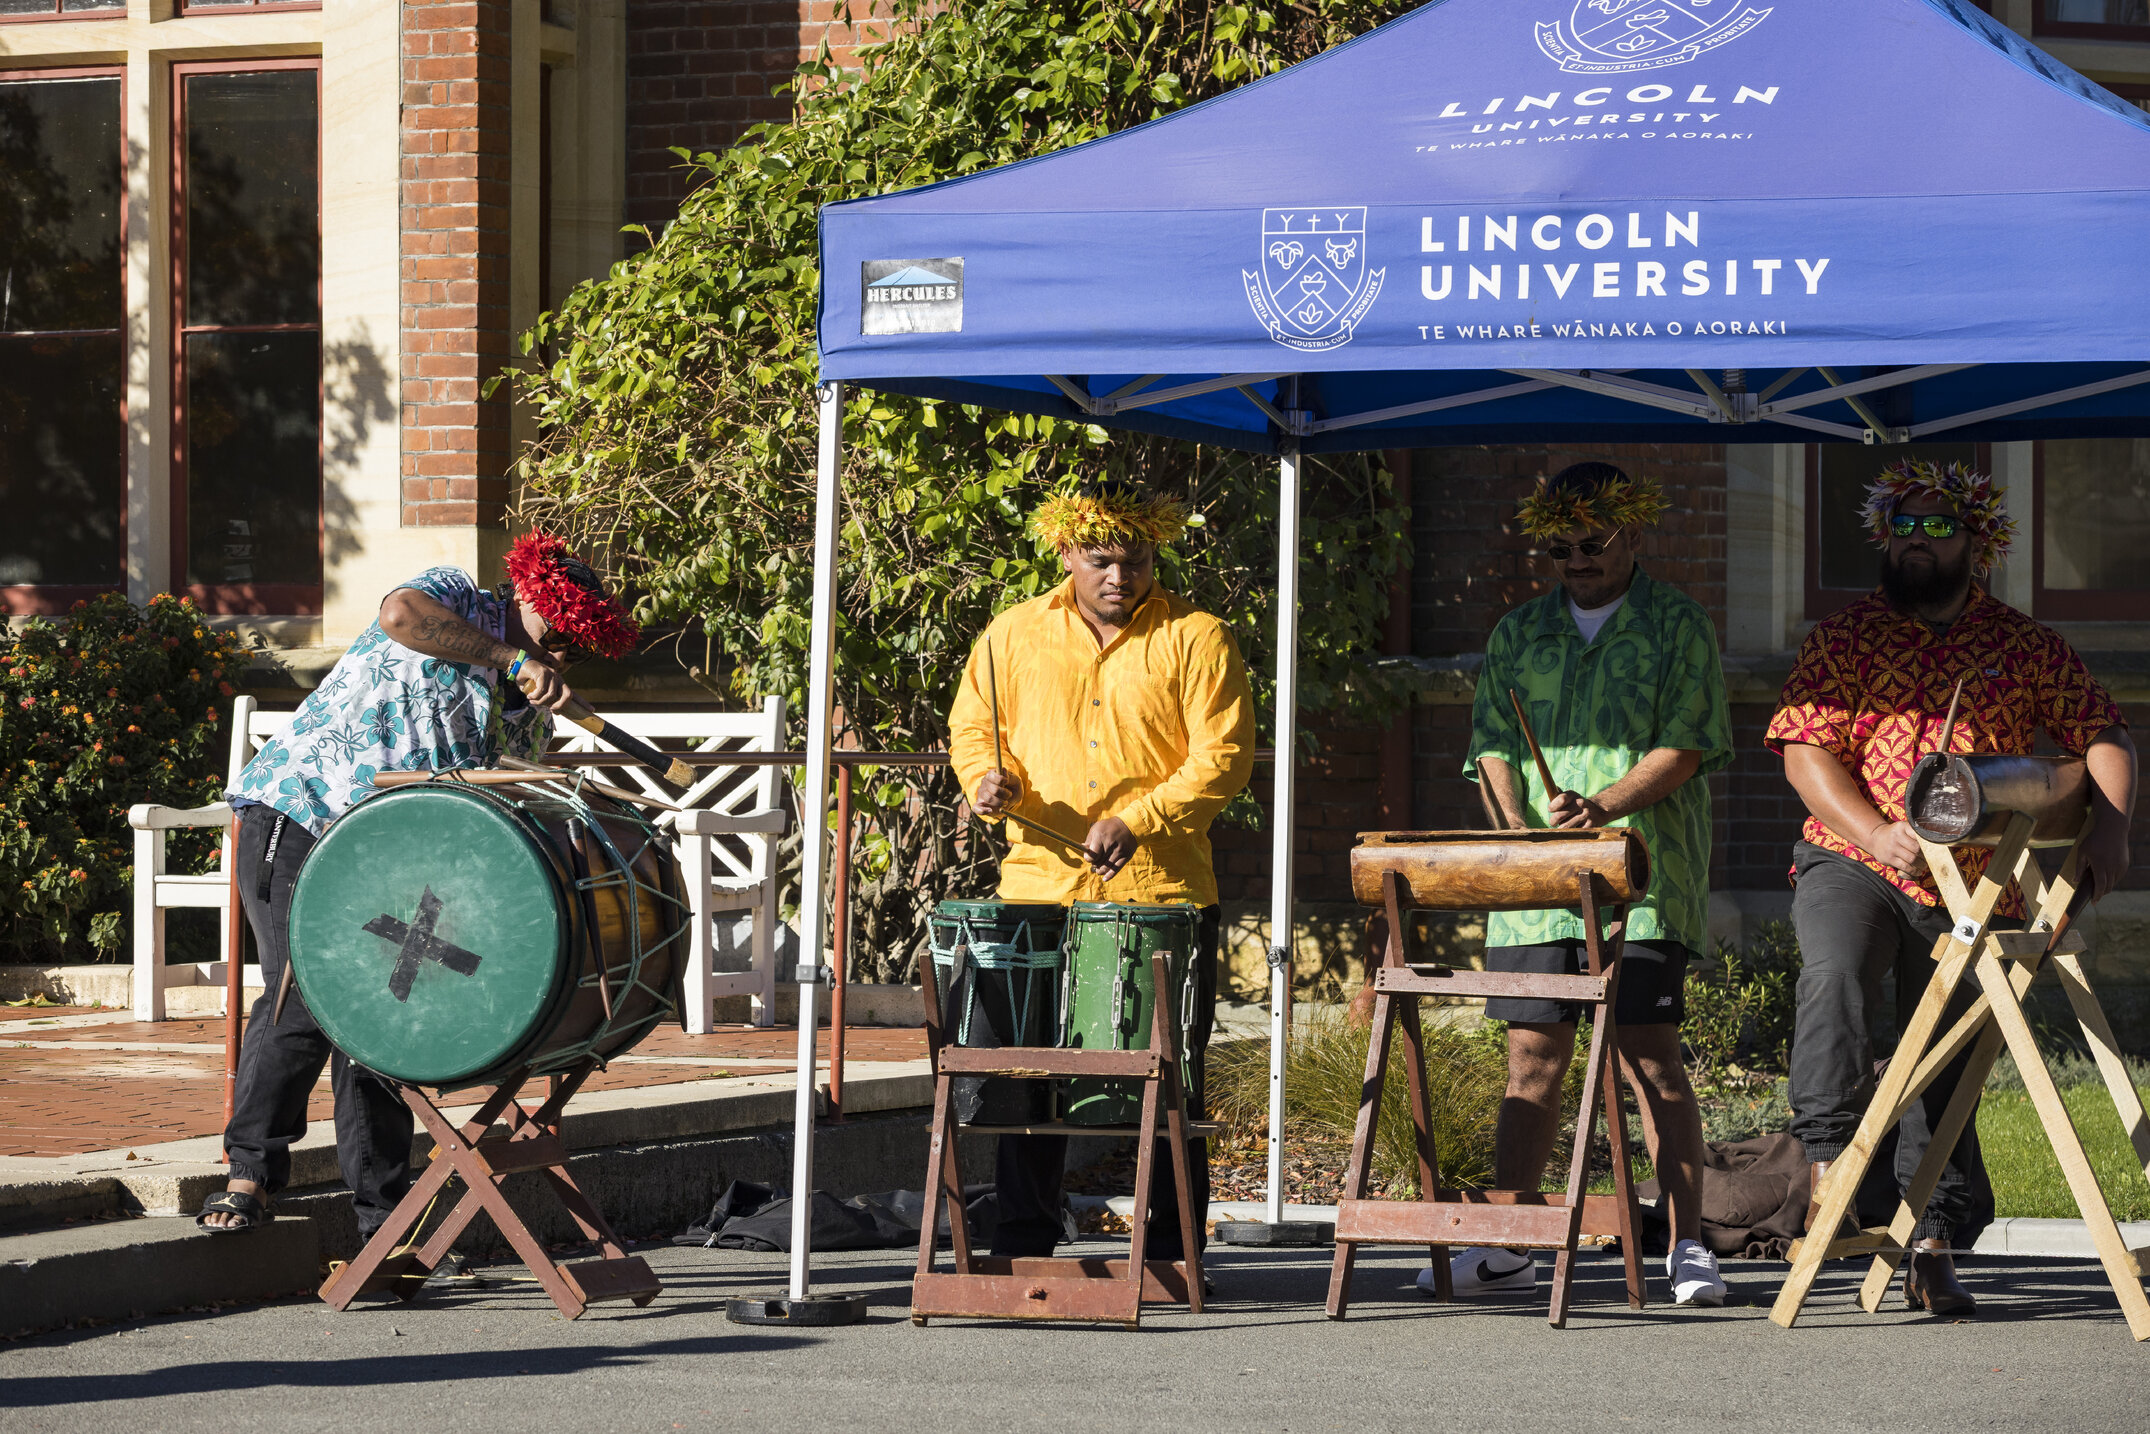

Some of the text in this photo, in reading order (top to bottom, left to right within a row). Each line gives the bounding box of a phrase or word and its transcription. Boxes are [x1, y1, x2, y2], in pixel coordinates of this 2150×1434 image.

[1542, 31, 1565, 56] SCIENTIA
[1704, 16, 1756, 46] PROBITATE
[1438, 84, 1780, 119] LINCOLN
[1472, 112, 1721, 134] UNIVERSITY
[1415, 145, 1439, 153] TE
[1450, 138, 1527, 150] WHARE
[1537, 132, 1630, 143] WĀNAKA
[1664, 132, 1753, 140] AORAKI
[1420, 211, 1699, 253] LINCOLN
[867, 286, 957, 302] HERCULES
[1420, 258, 1831, 301] UNIVERSITY
[1249, 285, 1269, 320] SCIENTIA
[1351, 280, 1379, 320] PROBITATE
[1417, 319, 1786, 340] TE WHARE WĀNAKA O AORAKI
[265, 815, 285, 863] CANTERBURY
